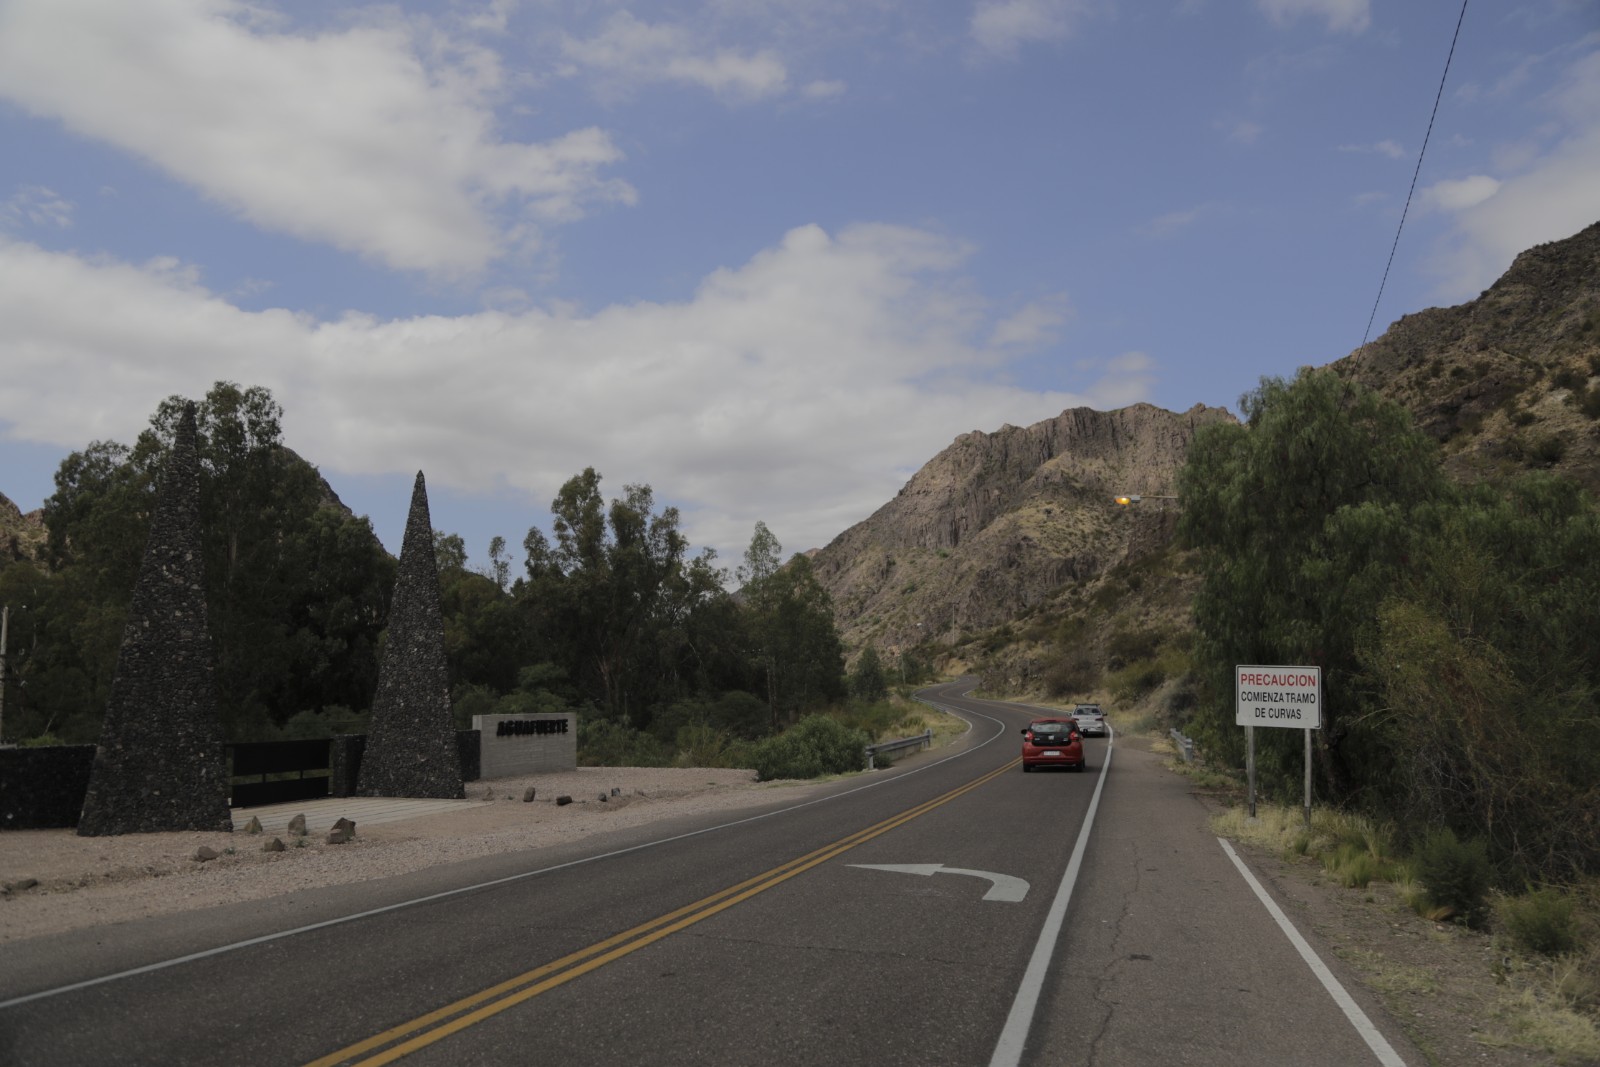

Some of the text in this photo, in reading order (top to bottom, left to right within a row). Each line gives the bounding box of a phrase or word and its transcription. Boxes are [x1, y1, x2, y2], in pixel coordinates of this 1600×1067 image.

[1241, 673, 1316, 687] PRECAUCION
[1241, 691, 1316, 704] COMIENZA TRAMO
[1255, 707, 1302, 720] DE CURVAS
[496, 718, 569, 736] AGUAFUERTE
